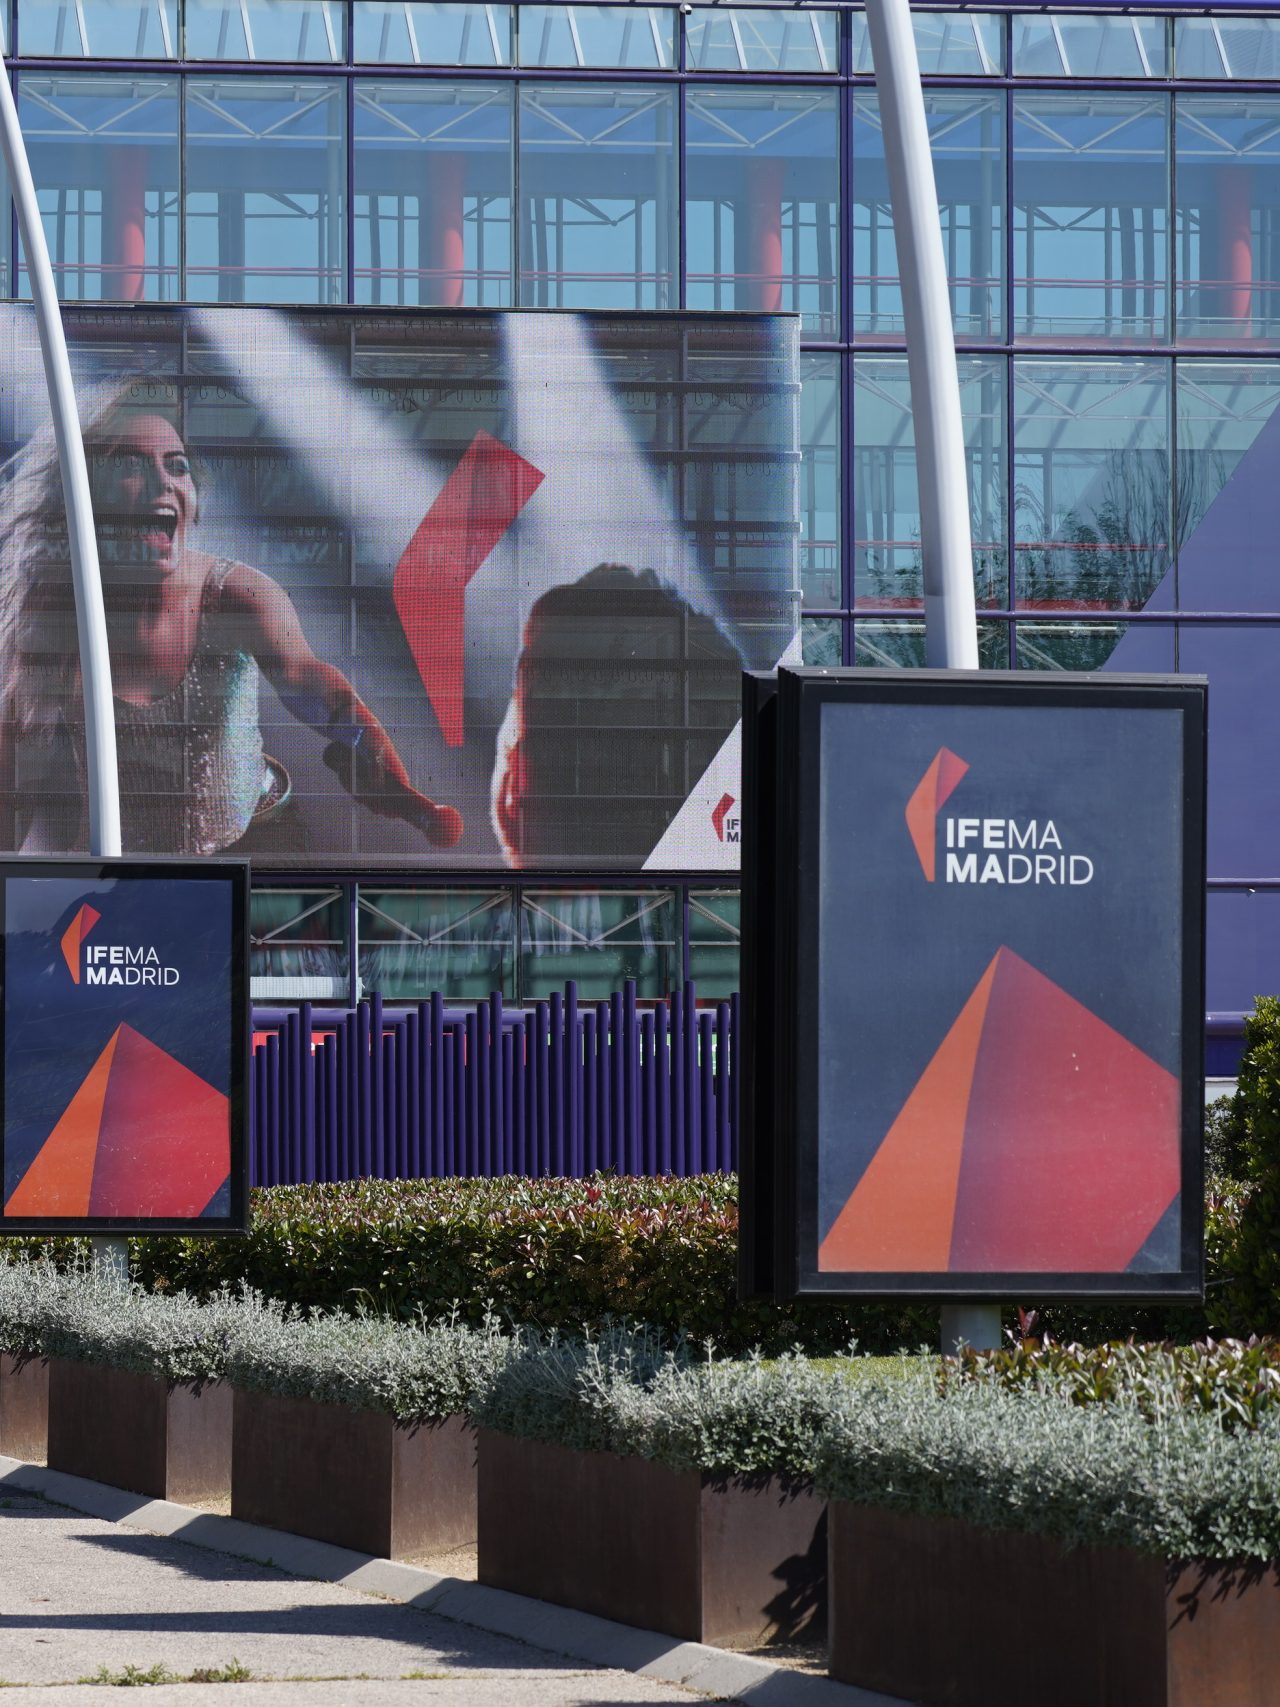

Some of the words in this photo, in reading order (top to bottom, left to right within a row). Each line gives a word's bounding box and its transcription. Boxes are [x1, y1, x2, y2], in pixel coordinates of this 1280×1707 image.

[946, 818, 1063, 851] IFEMA
[946, 853, 1095, 886] MADRID
[86, 945, 160, 965] IFEMA
[86, 966, 180, 986] MADRID
